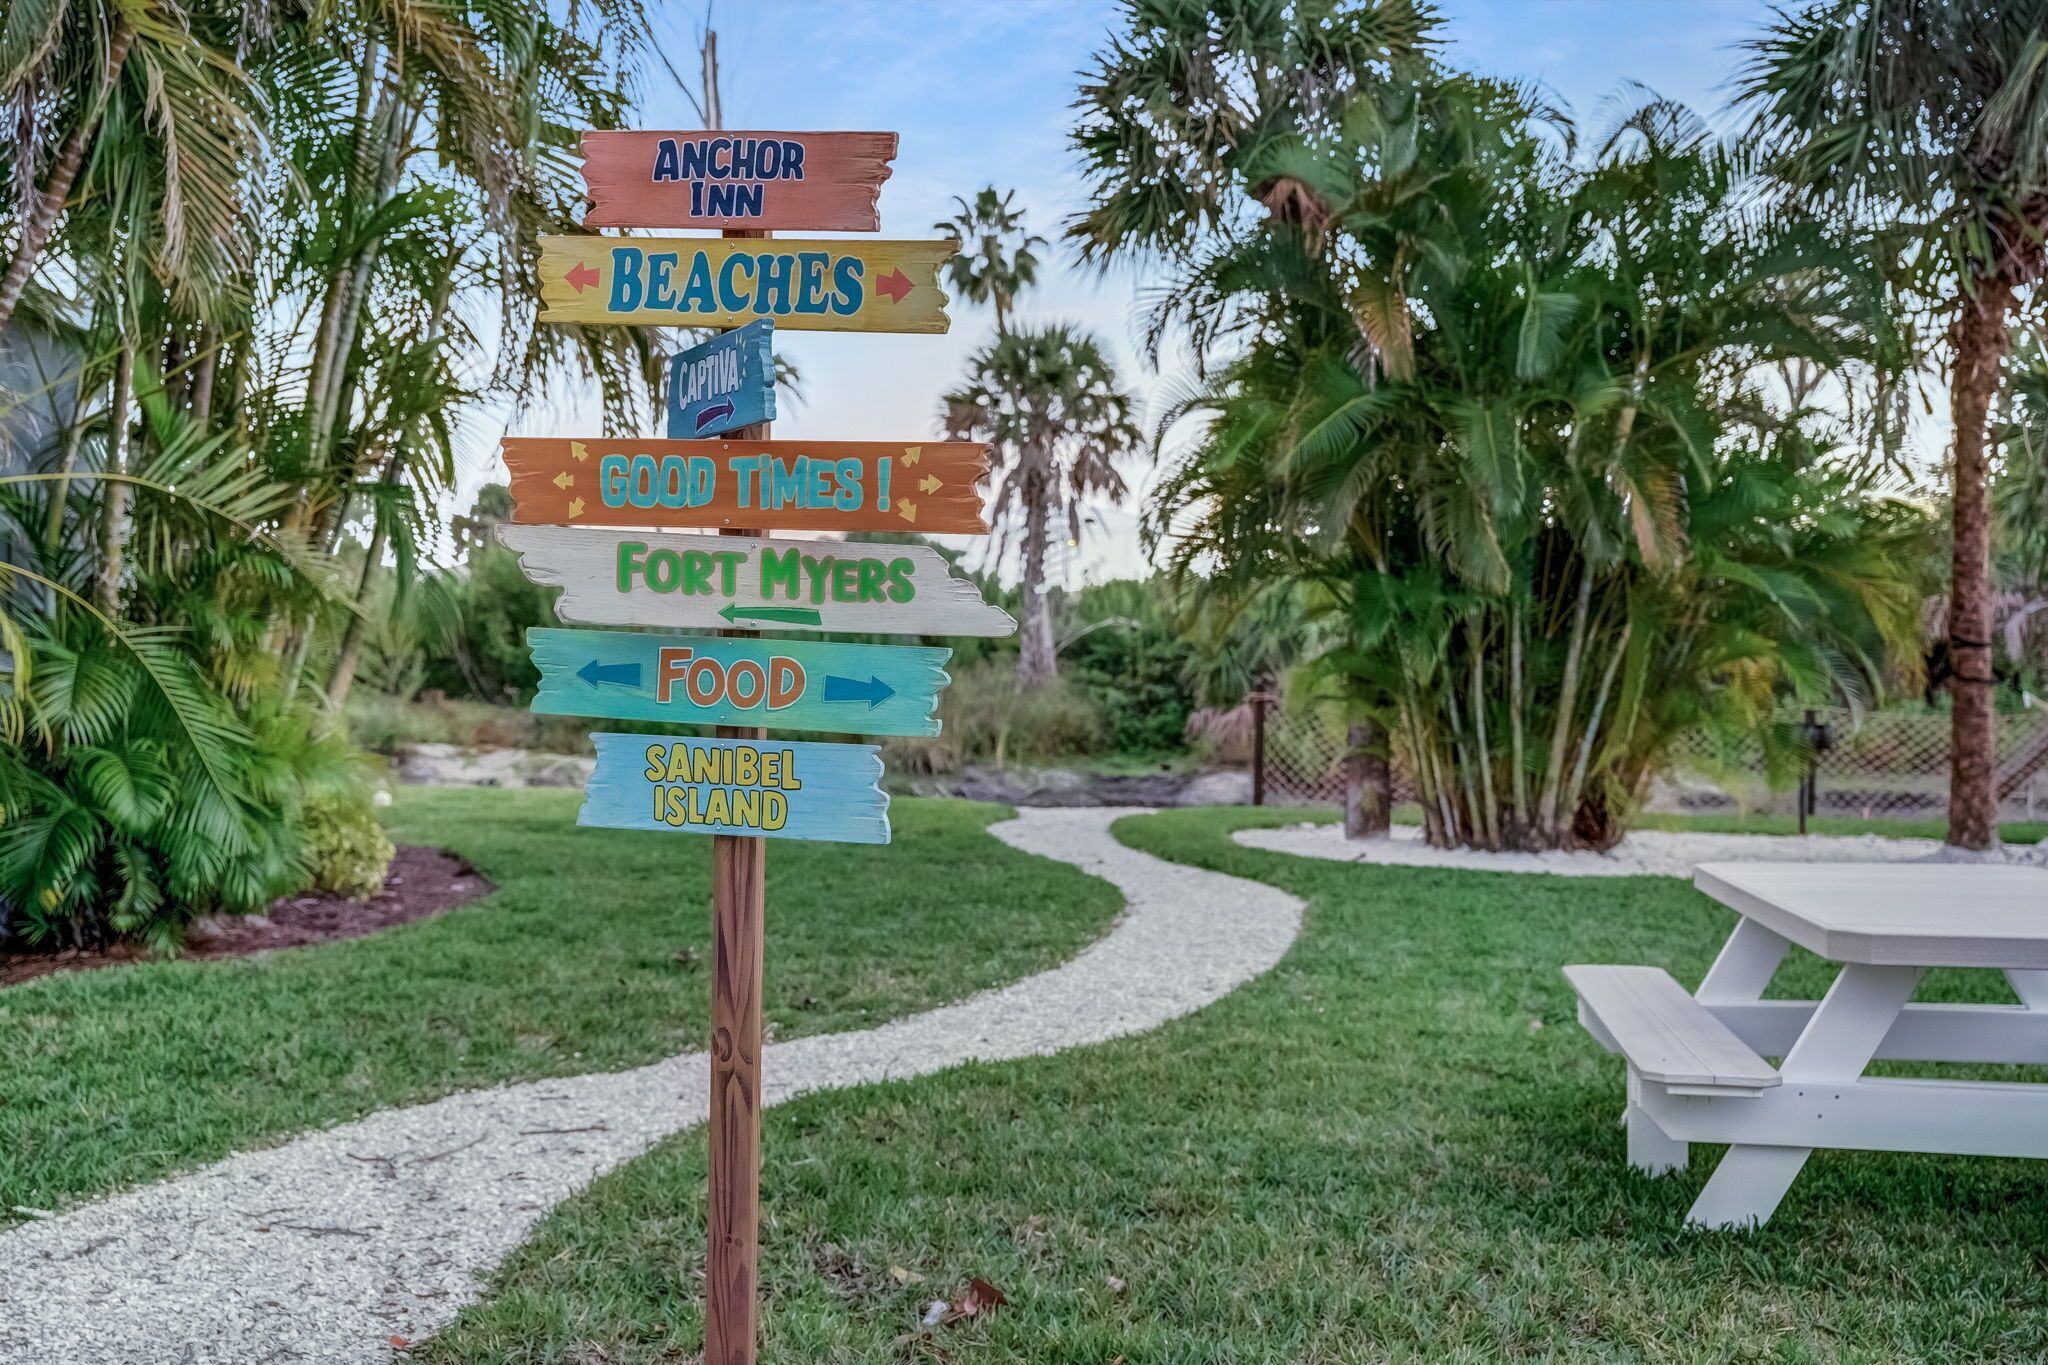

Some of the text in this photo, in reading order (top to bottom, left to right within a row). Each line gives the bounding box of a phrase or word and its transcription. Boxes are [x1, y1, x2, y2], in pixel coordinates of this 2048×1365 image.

[652, 137, 806, 182] ANCHOR
[688, 180, 765, 218] INN
[607, 246, 866, 316] BEACHES
[679, 346, 739, 411] CAPTIVA
[600, 454, 716, 509] GOOD
[877, 457, 893, 511] !
[616, 541, 916, 603] FORT MYERS
[656, 647, 807, 710] FOOD
[644, 743, 801, 790] SANIBEL
[653, 786, 788, 831] ISLAND
